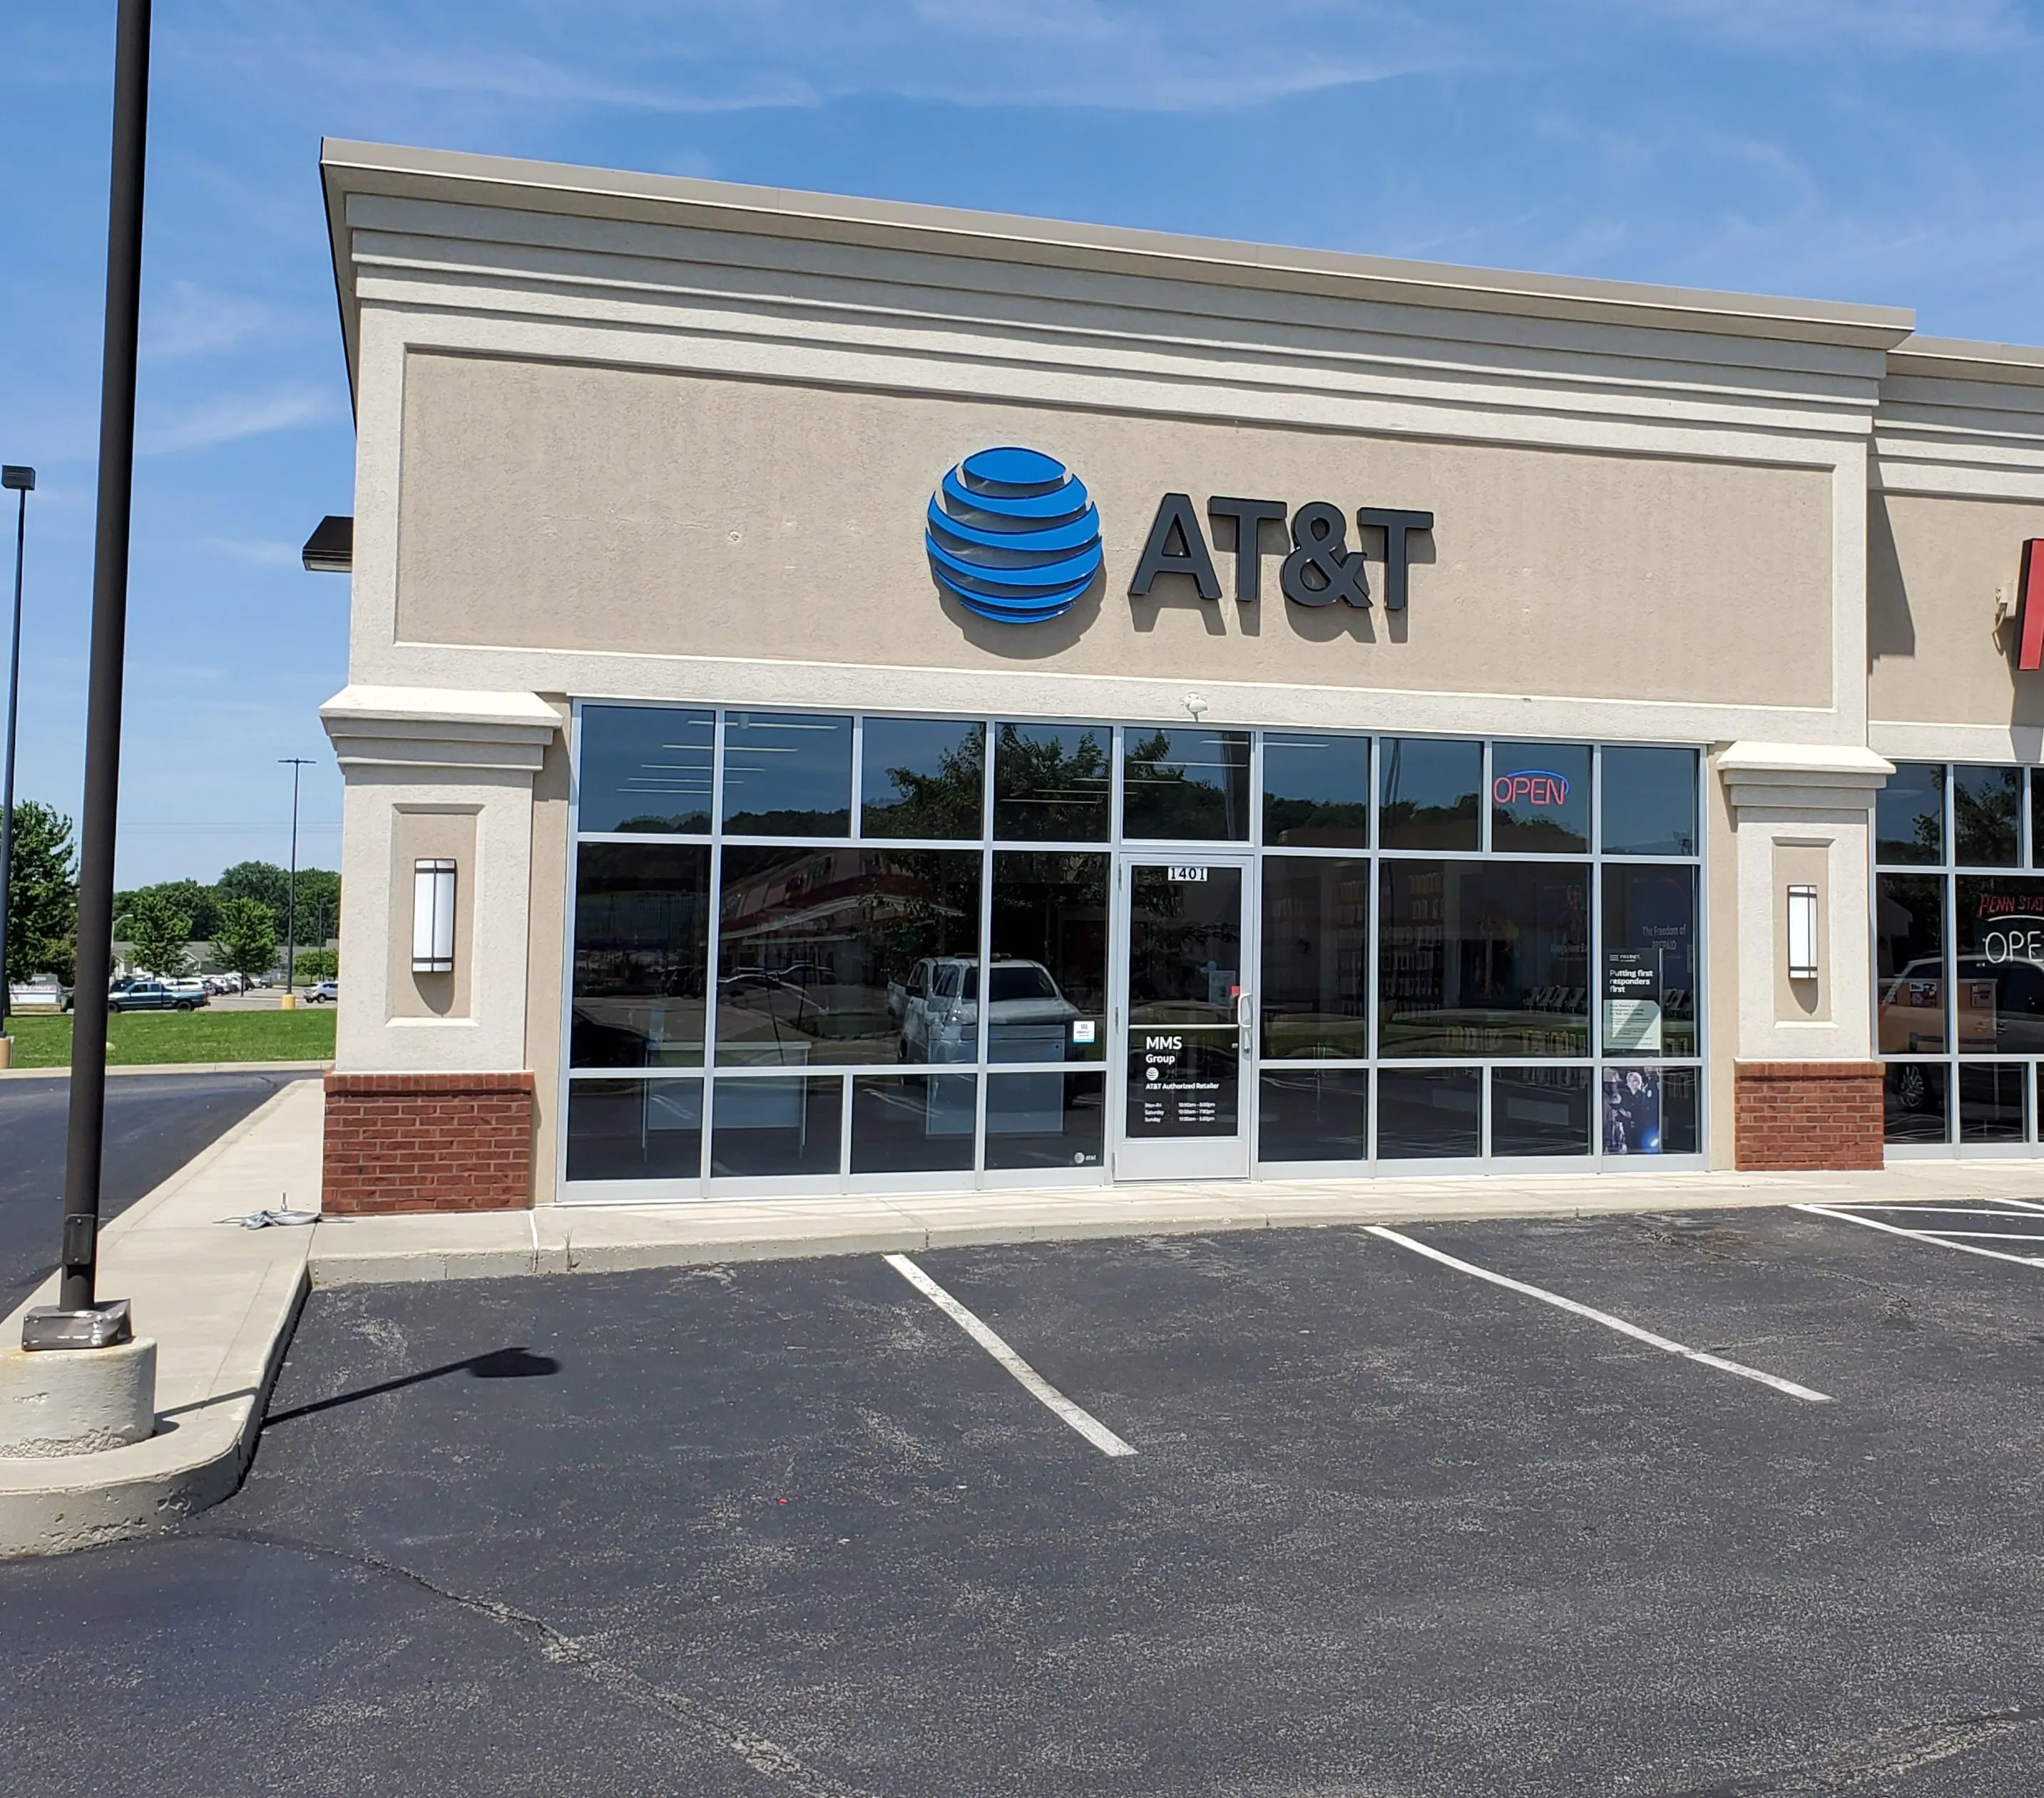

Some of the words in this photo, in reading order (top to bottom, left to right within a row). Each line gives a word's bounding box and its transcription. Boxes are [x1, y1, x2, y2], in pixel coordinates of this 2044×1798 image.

[1128, 493, 1434, 610] AT&T
[1493, 777, 1565, 804] OPEN
[1171, 867, 1205, 880] 1401
[1976, 893, 2015, 918] PENN
[1610, 969, 1637, 978] Putting
[1146, 1036, 1182, 1050] MMS
[1145, 1053, 1175, 1065] Group
